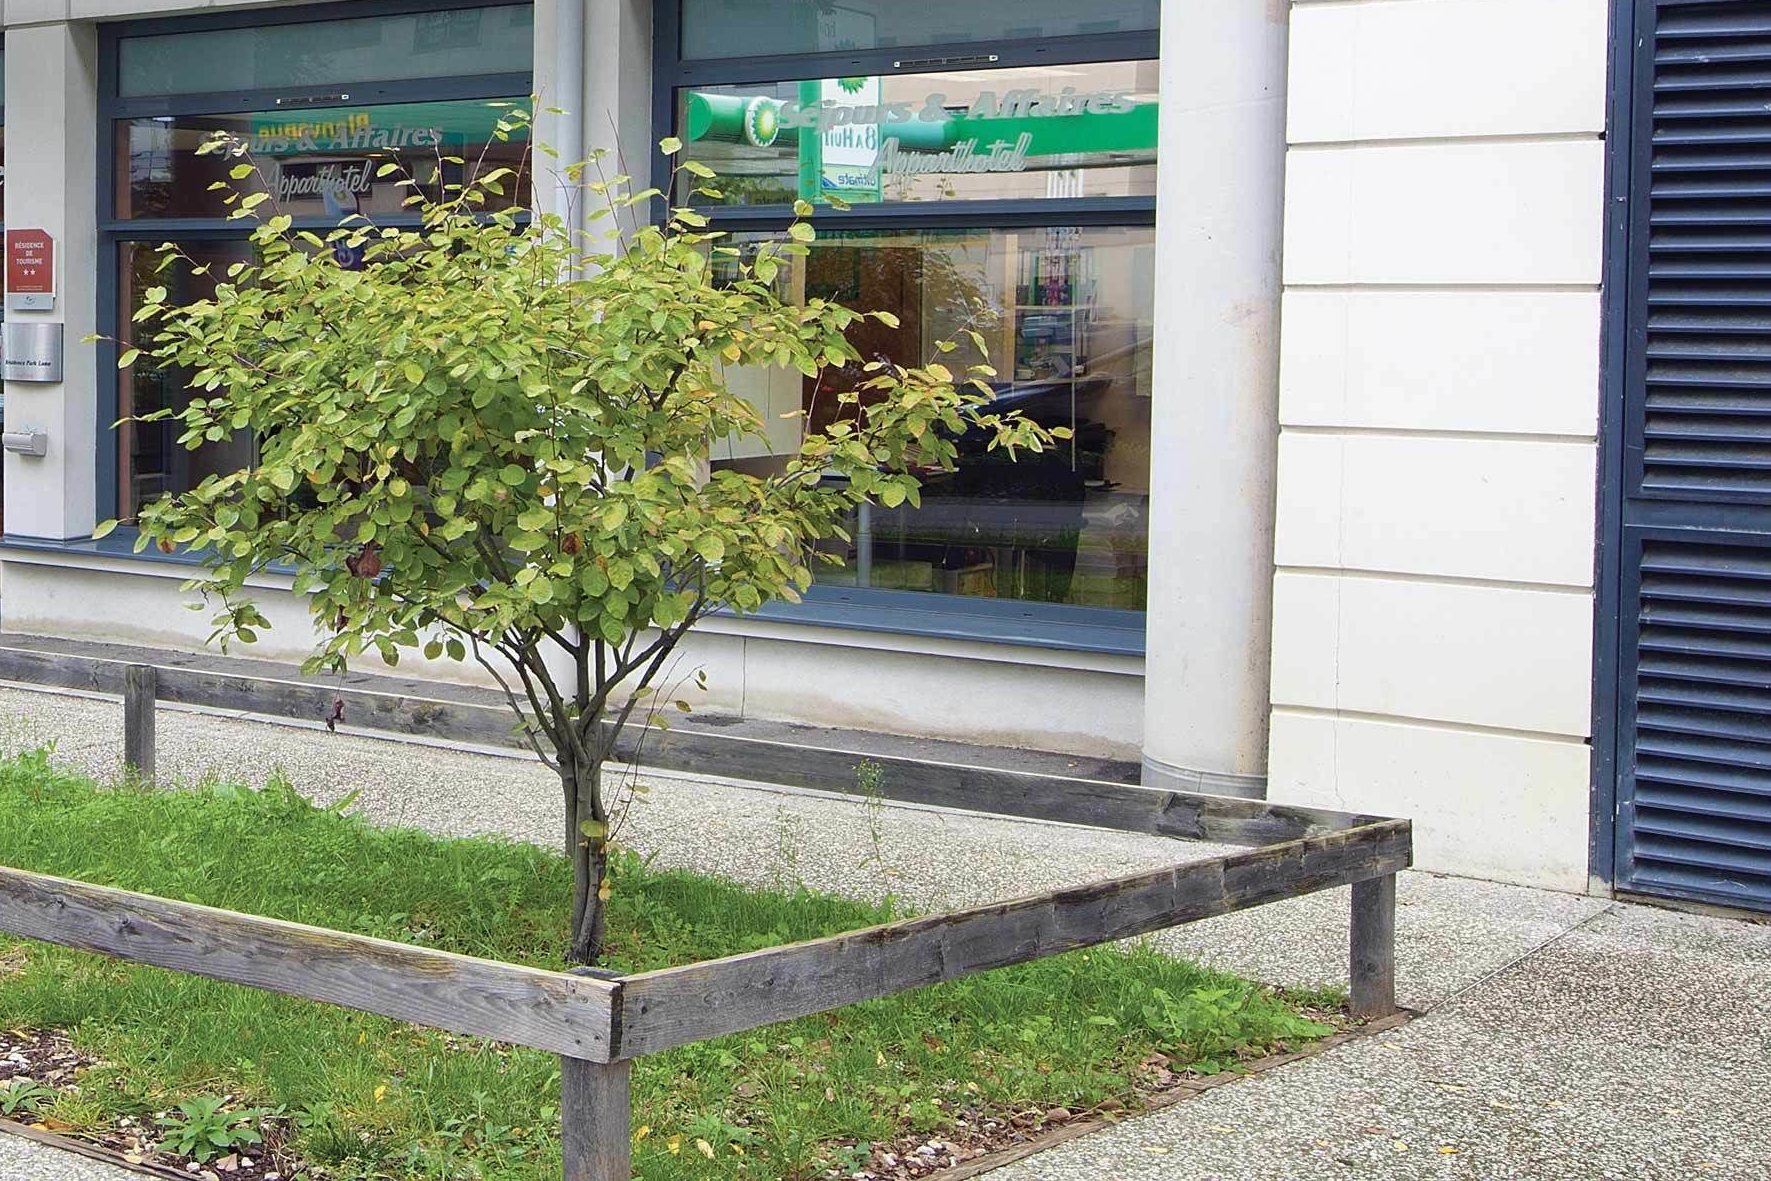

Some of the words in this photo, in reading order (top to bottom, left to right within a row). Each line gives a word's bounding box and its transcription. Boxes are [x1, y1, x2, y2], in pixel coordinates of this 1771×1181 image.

[918, 92, 951, 122] &
[965, 86, 1139, 118] Affaires
[327, 122, 443, 151] Affaires
[14, 241, 45, 250] RÉSIDENCE
